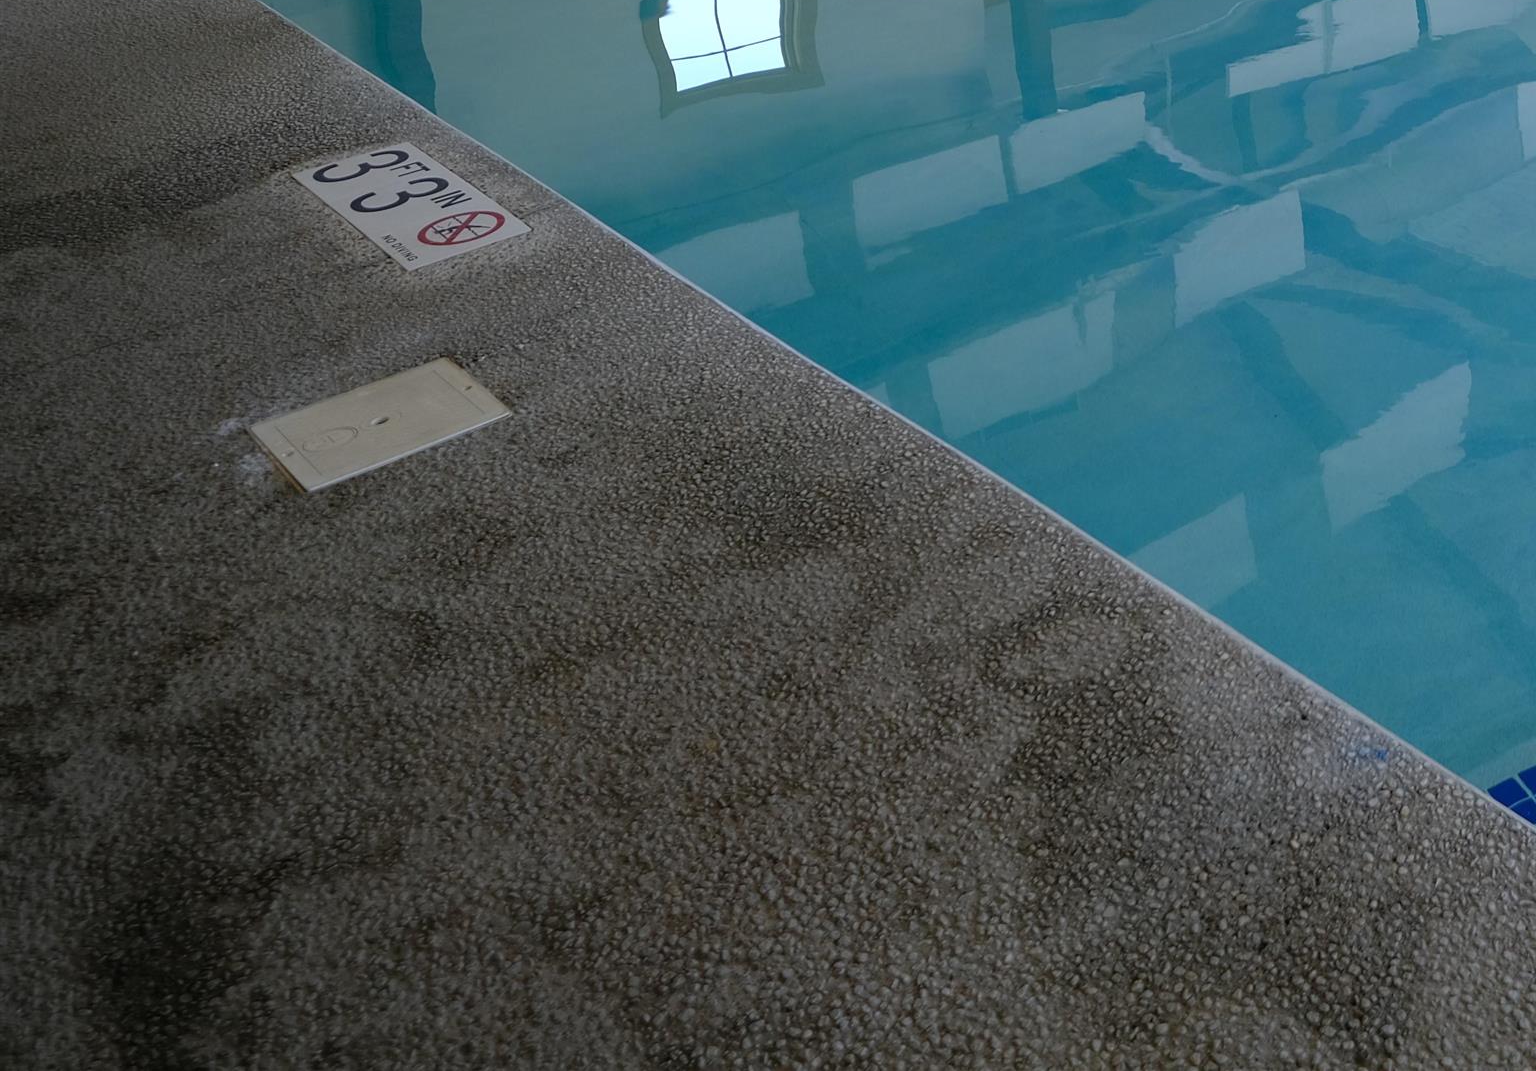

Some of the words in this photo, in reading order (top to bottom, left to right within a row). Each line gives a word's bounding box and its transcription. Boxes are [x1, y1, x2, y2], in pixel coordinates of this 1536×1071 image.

[312, 150, 410, 183] 3
[389, 161, 431, 178] FT
[350, 177, 450, 213] 3
[430, 189, 473, 209] IN
[381, 233, 398, 245] NO
[391, 241, 418, 262] DIVING
